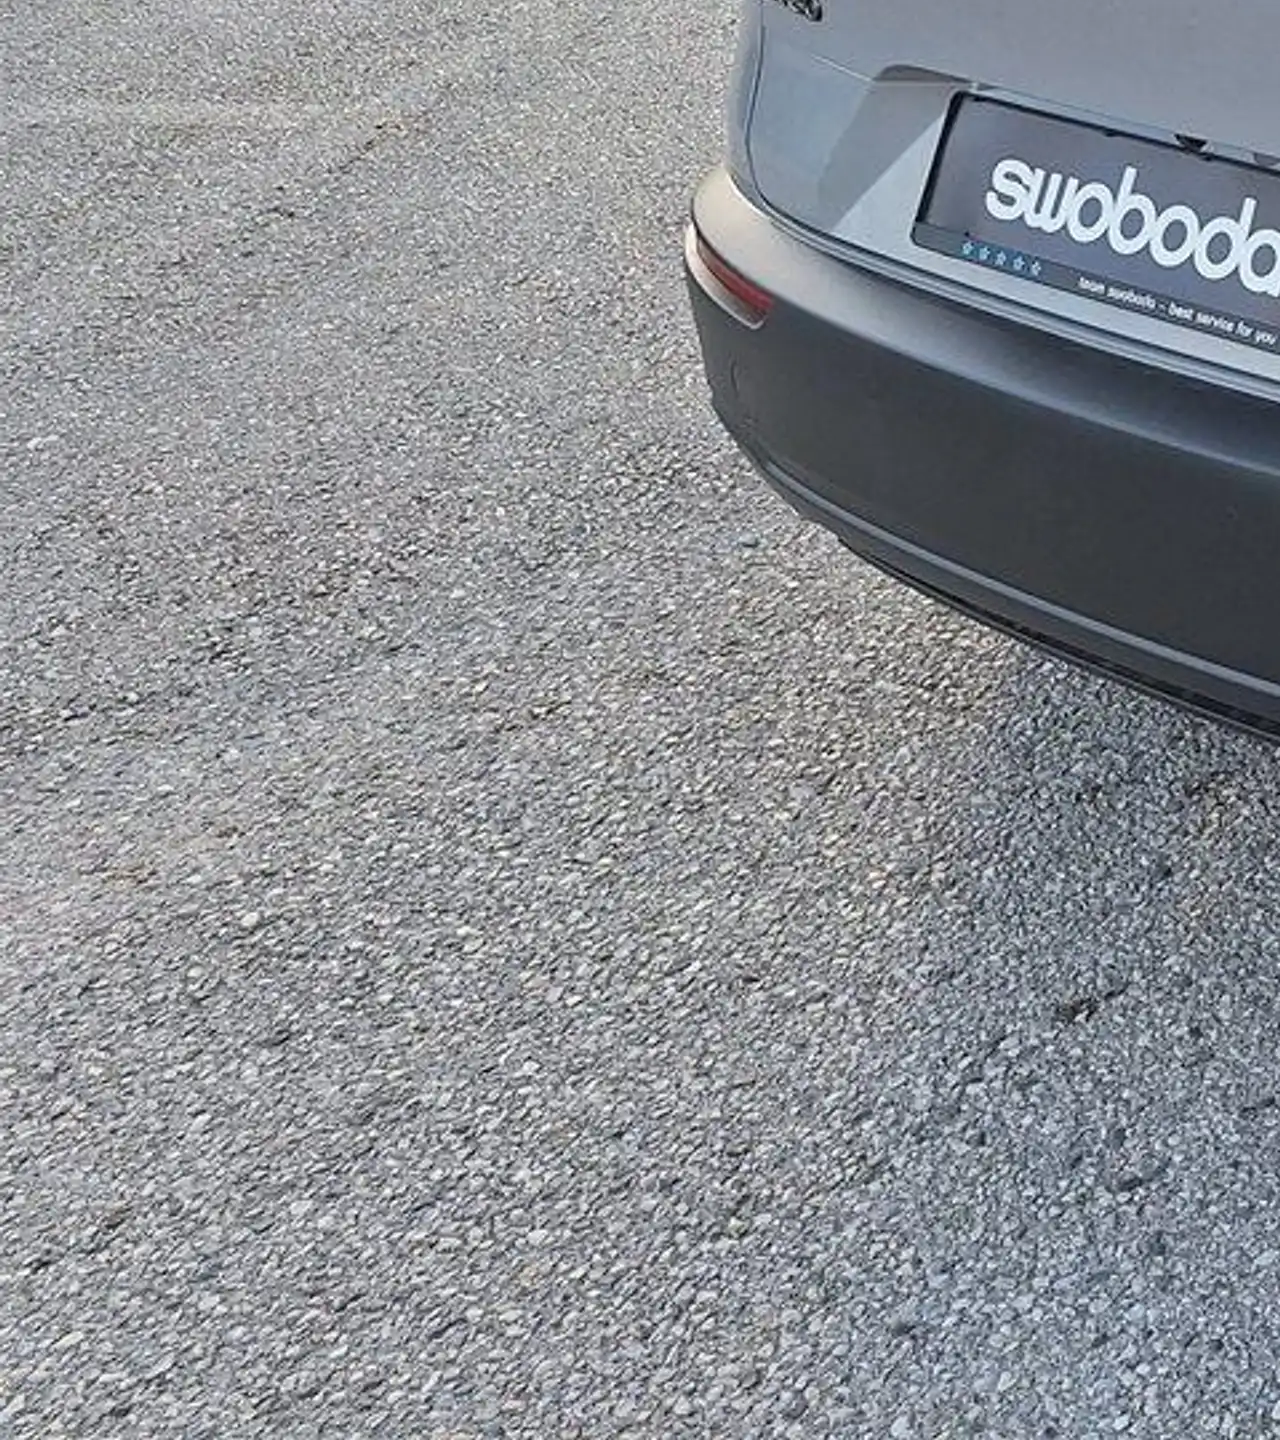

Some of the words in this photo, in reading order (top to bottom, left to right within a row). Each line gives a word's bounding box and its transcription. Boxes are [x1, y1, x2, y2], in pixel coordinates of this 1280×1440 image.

[1168, 301, 1195, 322] best
[1194, 311, 1234, 333] service
[1234, 320, 1253, 338] for
[1252, 328, 1279, 346] you
